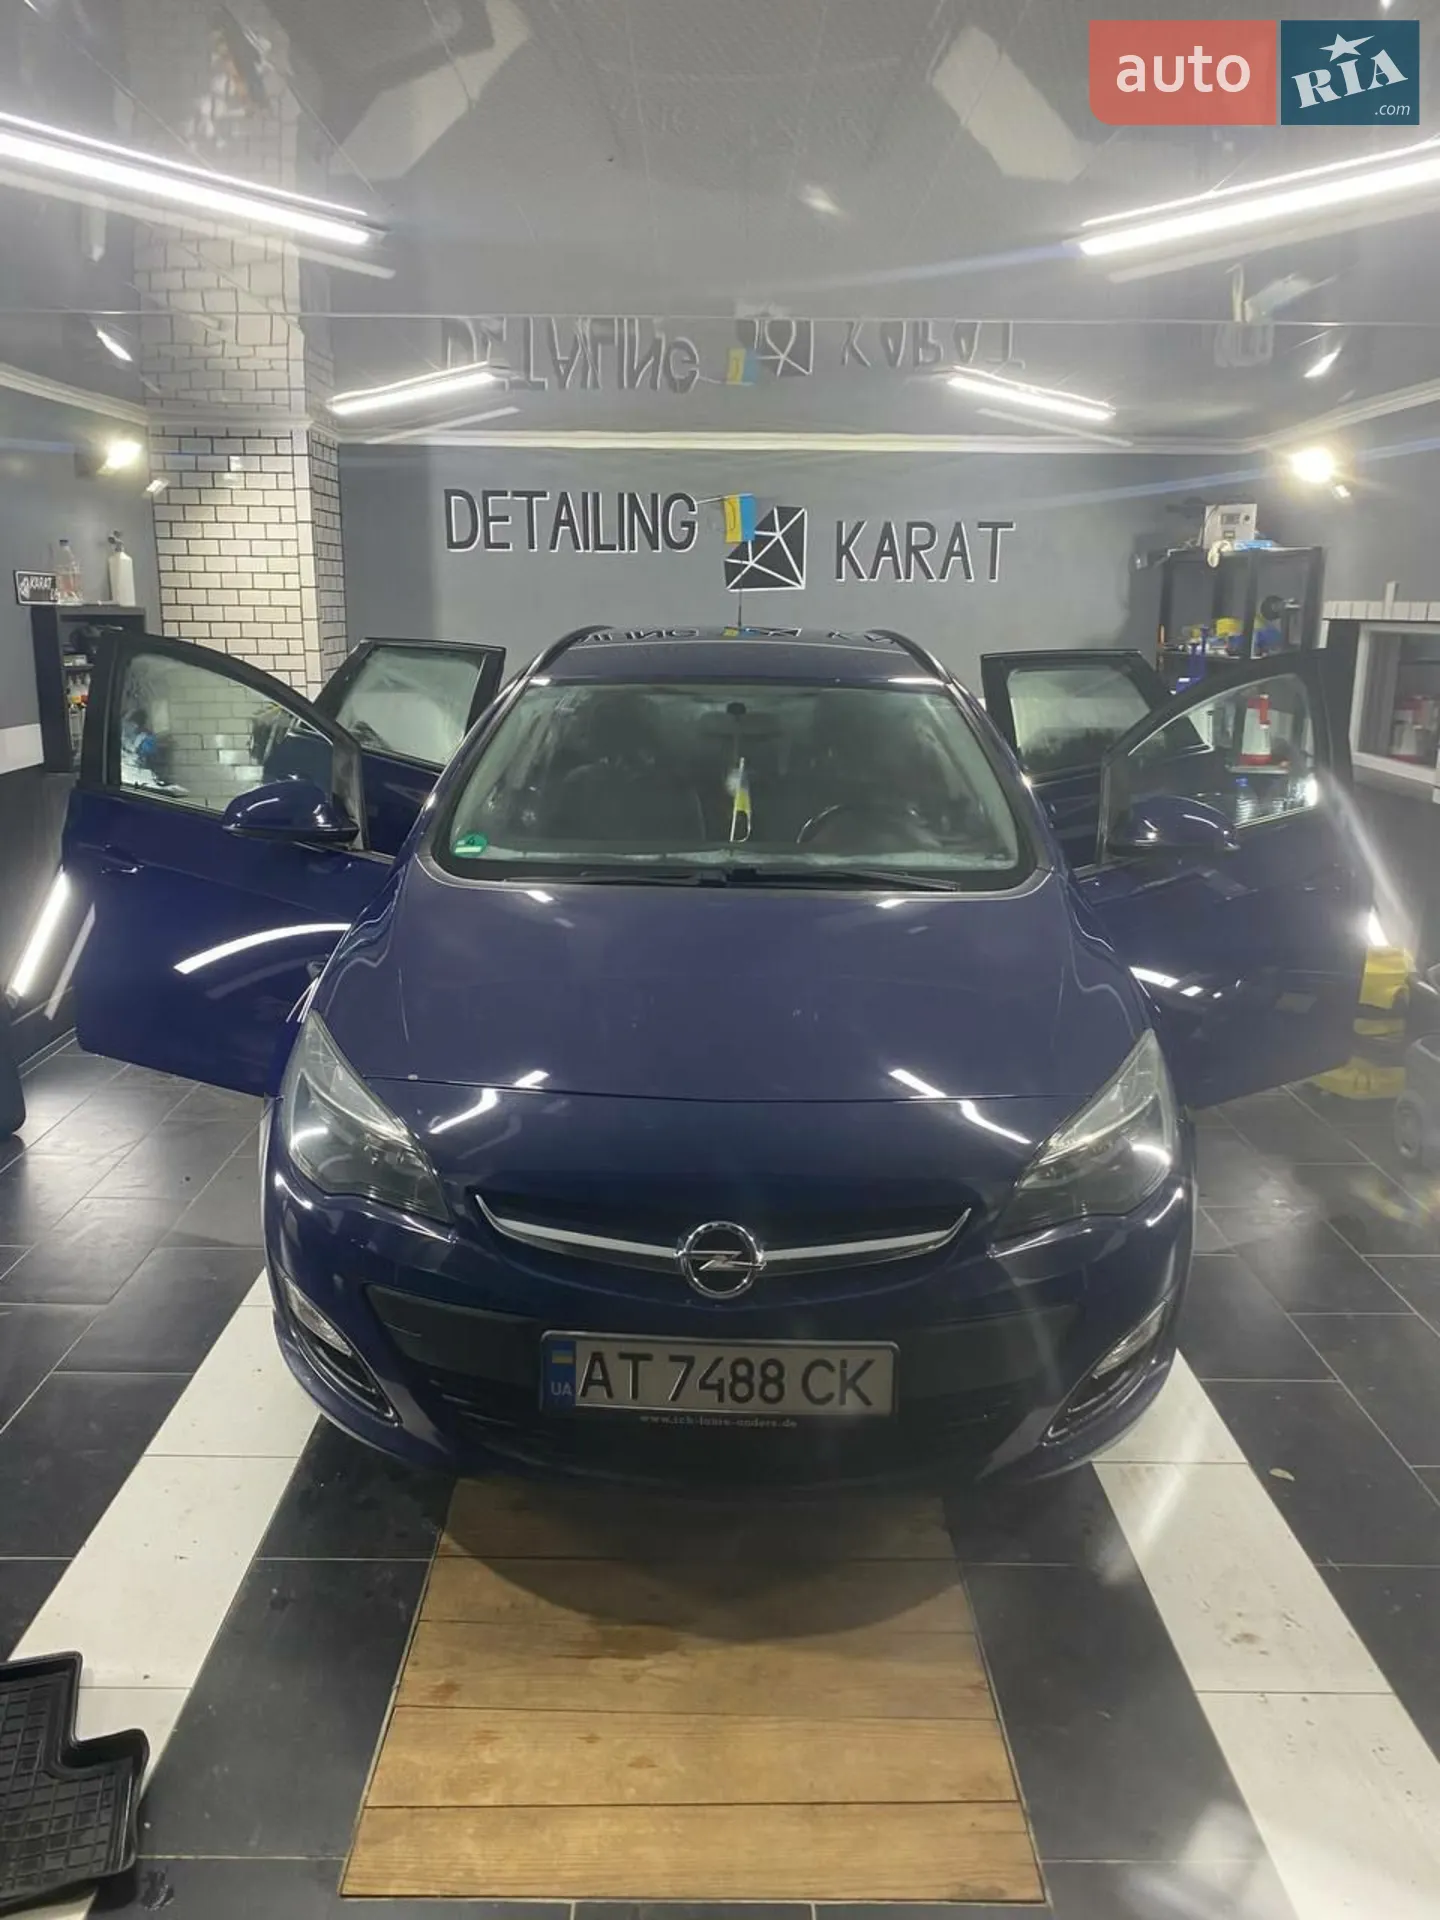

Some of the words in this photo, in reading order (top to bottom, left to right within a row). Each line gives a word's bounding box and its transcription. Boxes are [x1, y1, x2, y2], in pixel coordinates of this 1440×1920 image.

[443, 488, 698, 553] DETAILING
[834, 520, 1017, 583] KARAT
[551, 1382, 572, 1397] UA
[577, 1351, 653, 1400] AT
[667, 1355, 785, 1405] 7488
[802, 1358, 876, 1407] CK
